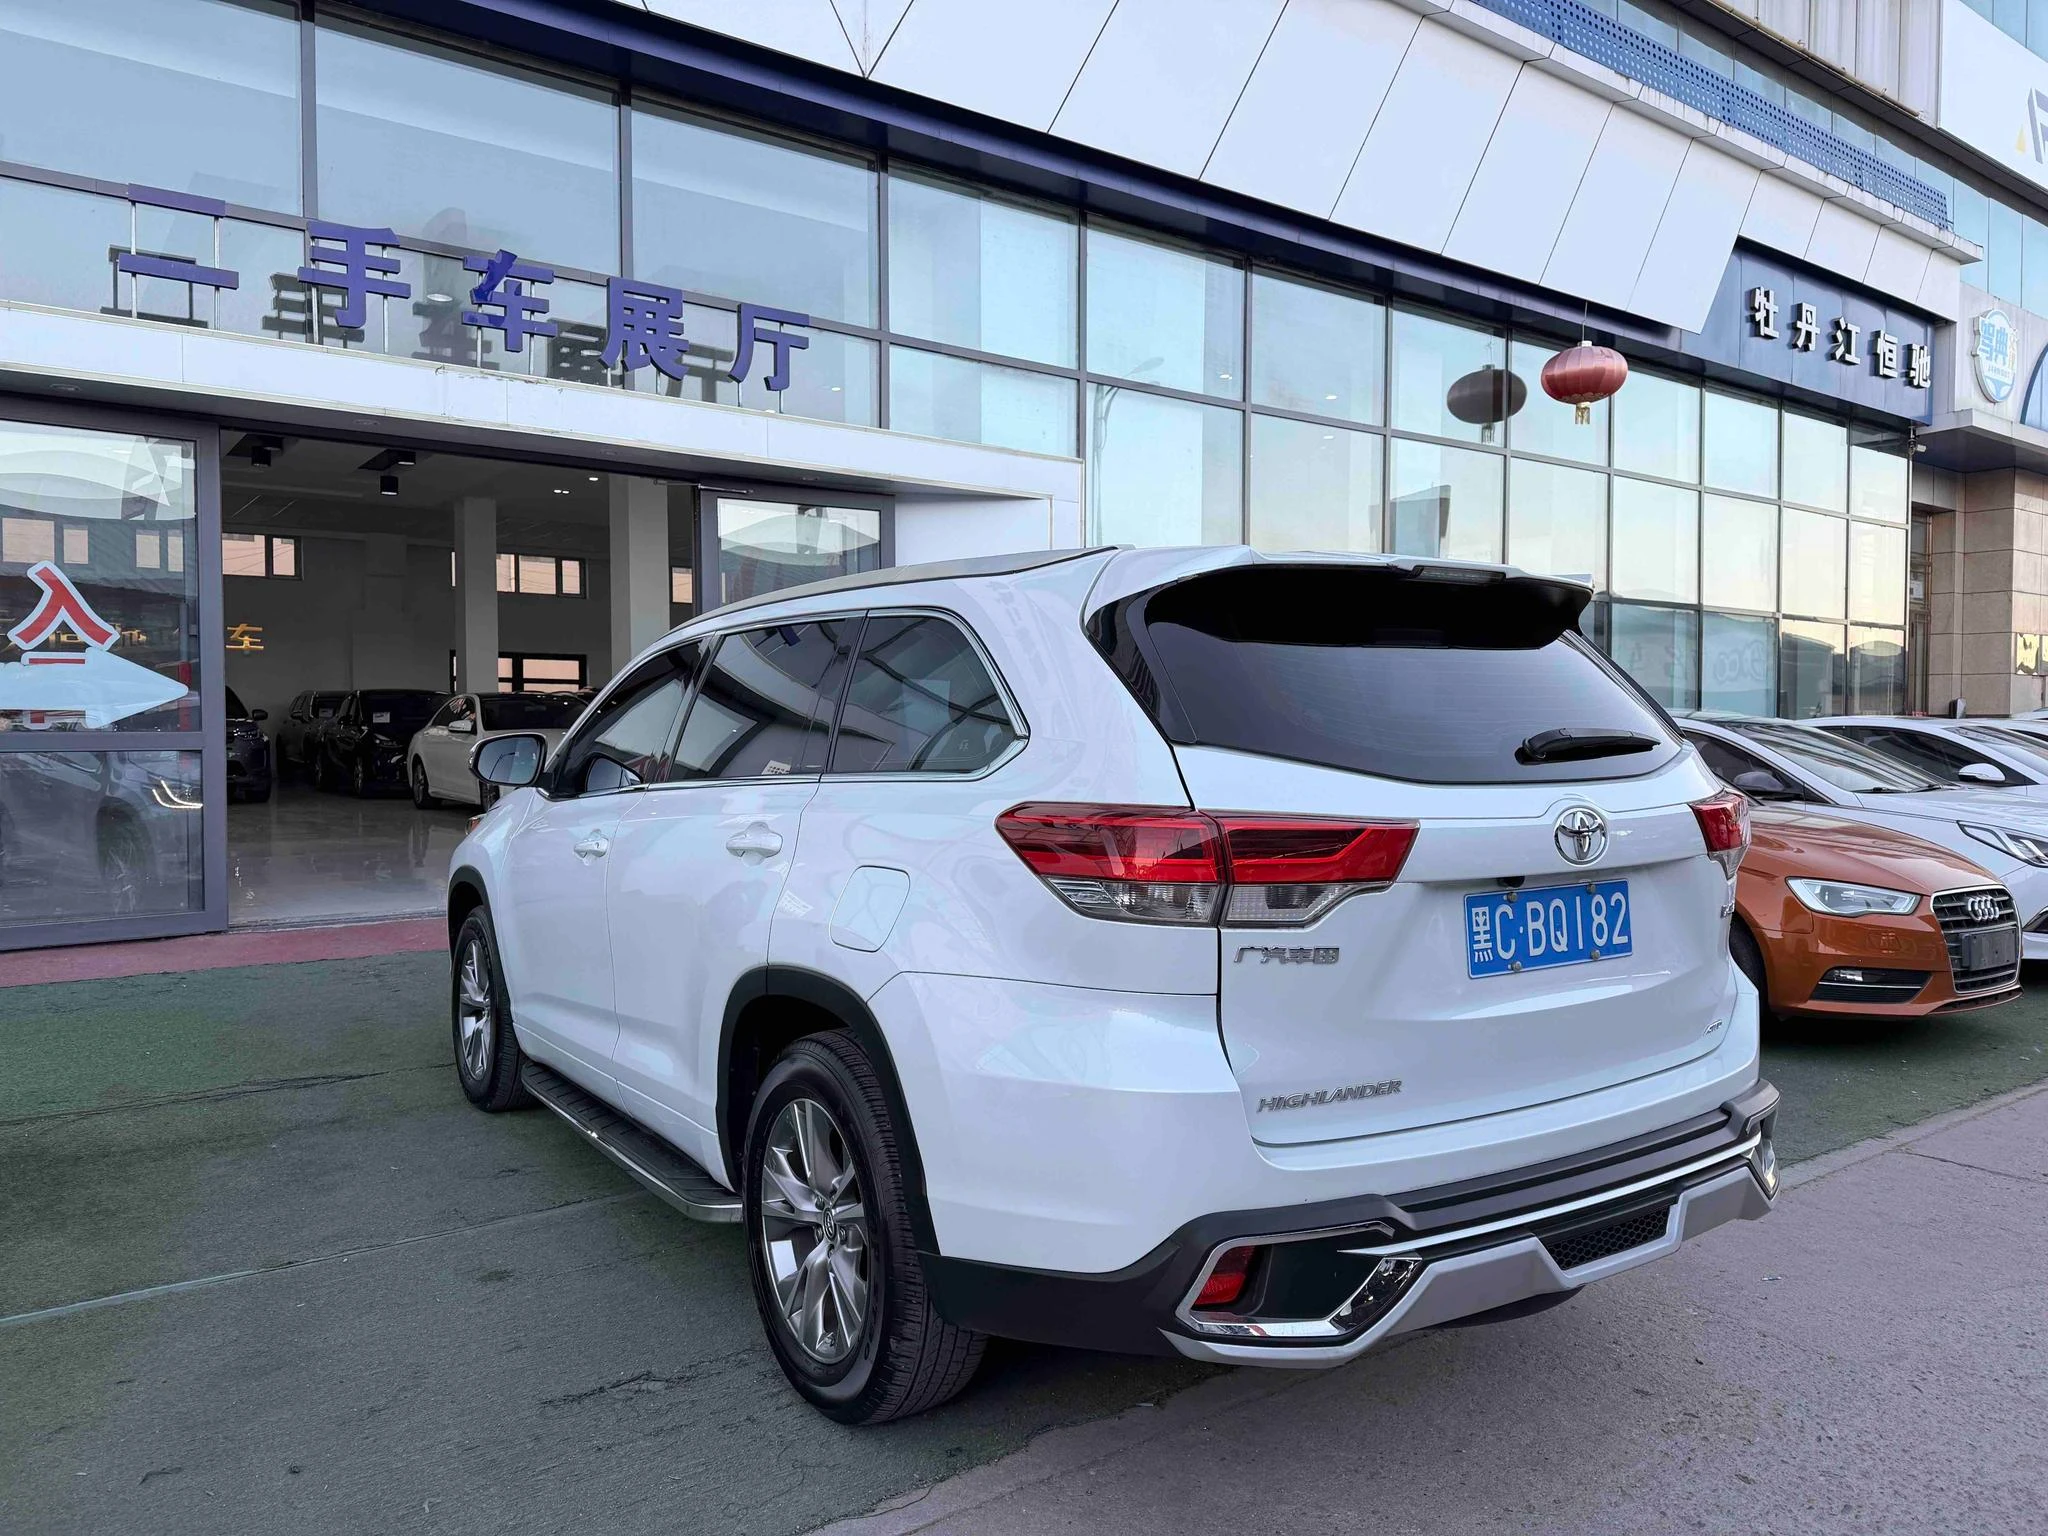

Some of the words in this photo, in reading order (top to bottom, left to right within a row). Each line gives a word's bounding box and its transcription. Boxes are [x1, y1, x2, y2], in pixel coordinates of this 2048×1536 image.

[118, 183, 810, 392] 二手车展厅
[1752, 286, 1932, 389] 牡丹江恒驰
[1234, 946, 1340, 964] 广汽丰田
[1256, 1079, 1402, 1113] HIGHLANDER
